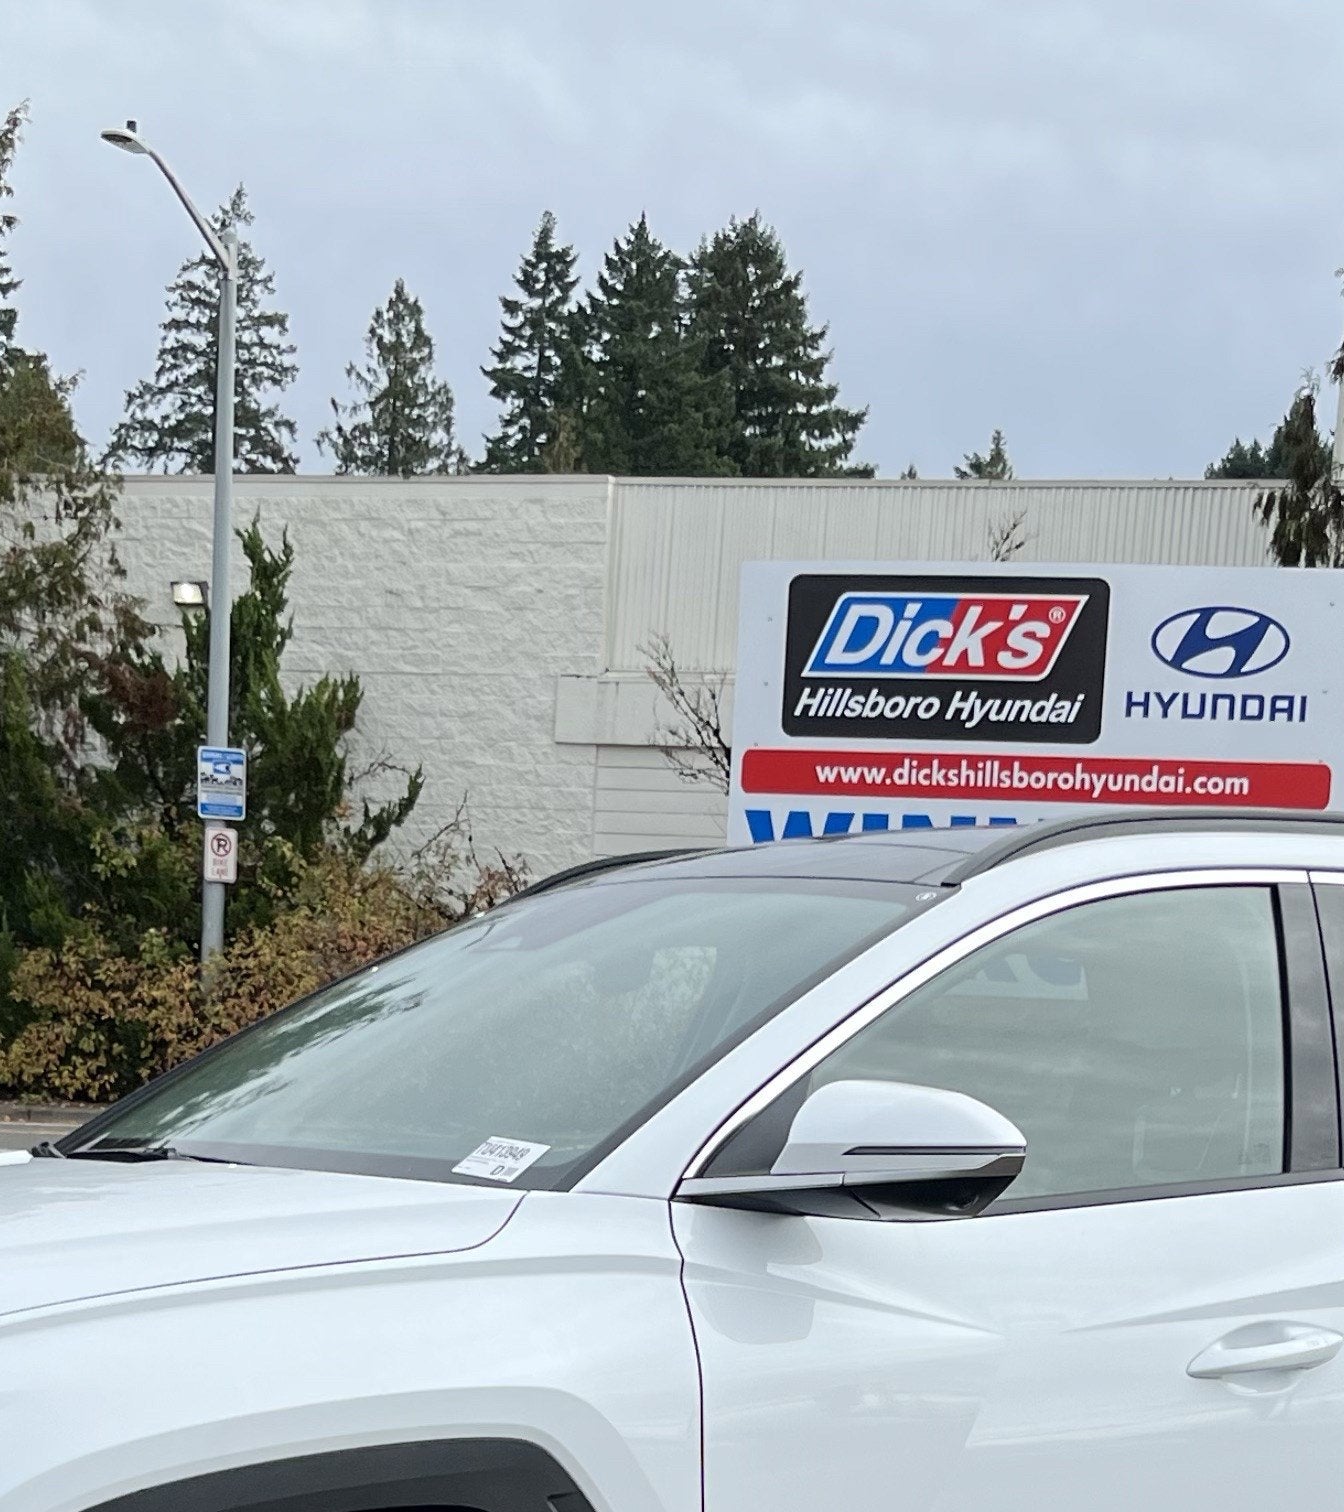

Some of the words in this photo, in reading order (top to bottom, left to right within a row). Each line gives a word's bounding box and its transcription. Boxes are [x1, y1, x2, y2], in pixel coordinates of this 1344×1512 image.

[793, 688, 939, 723] Hillsboro
[950, 692, 1085, 729] Hyundai
[1125, 690, 1308, 723] HYUNDAI
[815, 760, 1250, 797] www.dickshillsborohyundai.com
